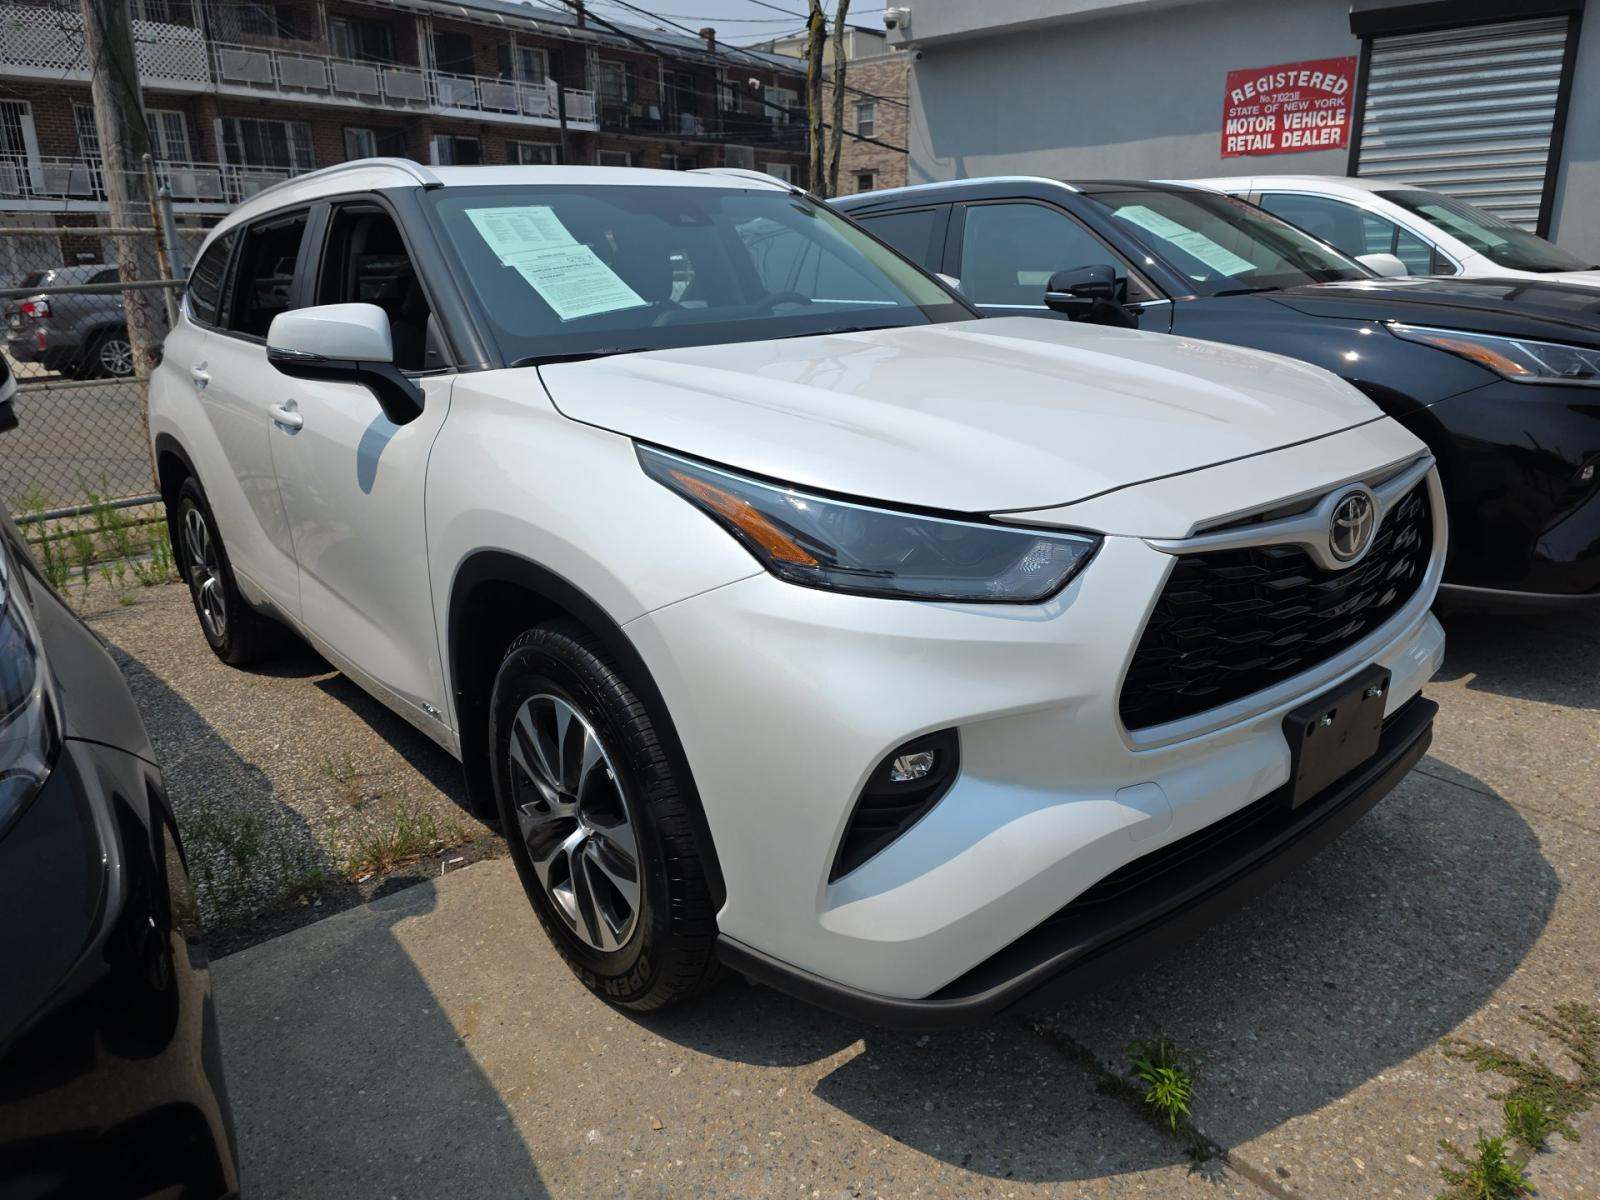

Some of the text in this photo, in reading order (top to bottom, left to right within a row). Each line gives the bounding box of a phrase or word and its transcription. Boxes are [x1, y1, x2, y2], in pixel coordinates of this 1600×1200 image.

[1231, 71, 1348, 105] REGISTERED
[1229, 98, 1344, 116] STATE OF NEW YORK
[1226, 109, 1346, 135] MOTOR VEHICLE
[1227, 128, 1341, 152] RETAIL DEALER
